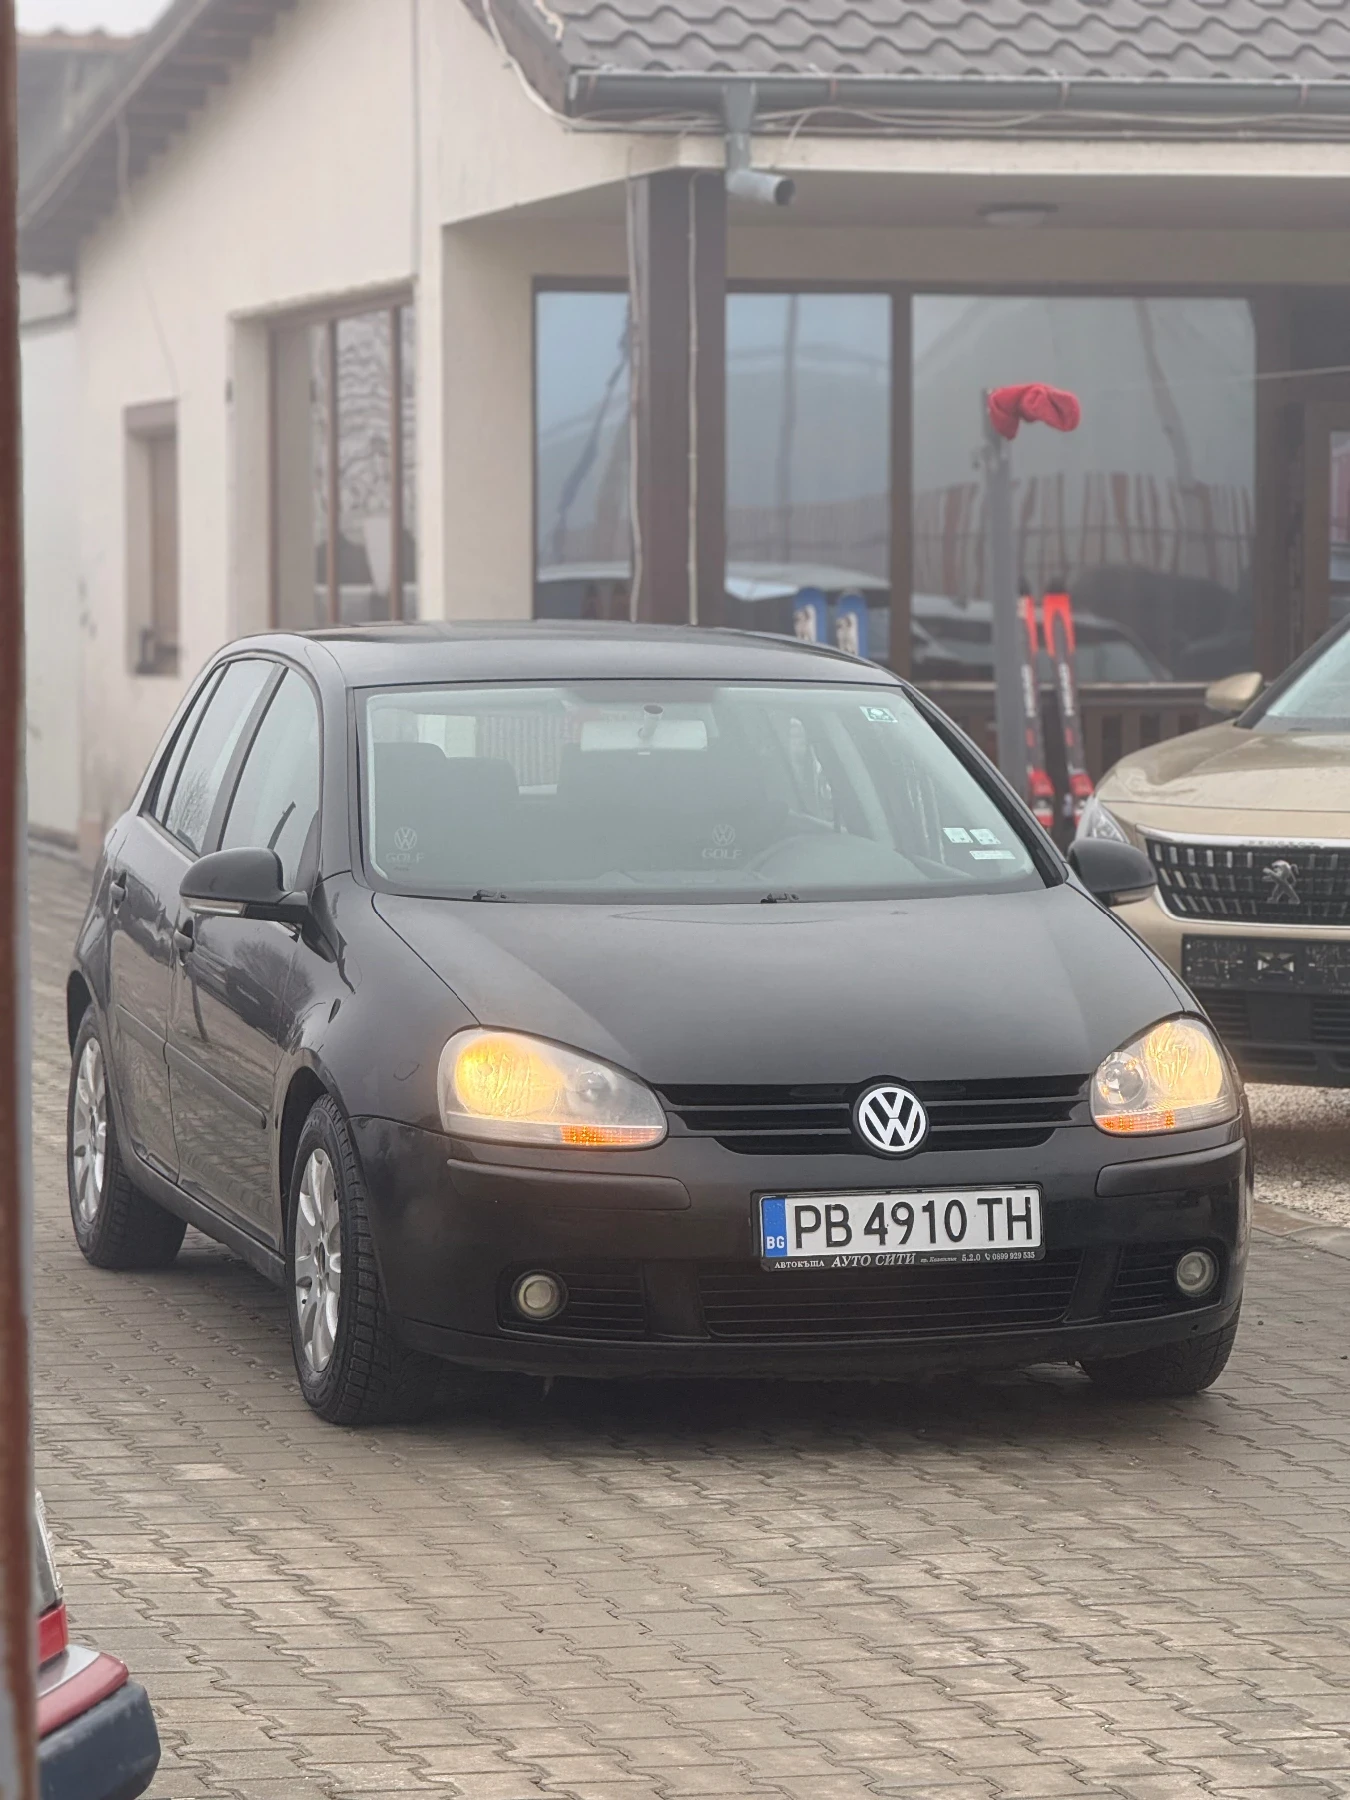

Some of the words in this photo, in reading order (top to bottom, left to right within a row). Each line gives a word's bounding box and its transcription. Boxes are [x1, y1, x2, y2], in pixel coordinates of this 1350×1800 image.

[702, 848, 742, 859] GOLF
[794, 1203, 853, 1249] PB
[863, 1199, 968, 1246] 4910
[976, 1196, 1033, 1242] TH
[766, 1236, 785, 1250] BG
[831, 1255, 872, 1268] АУТО
[875, 1252, 916, 1266] СИТИ
[1010, 1252, 1022, 1260] 929
